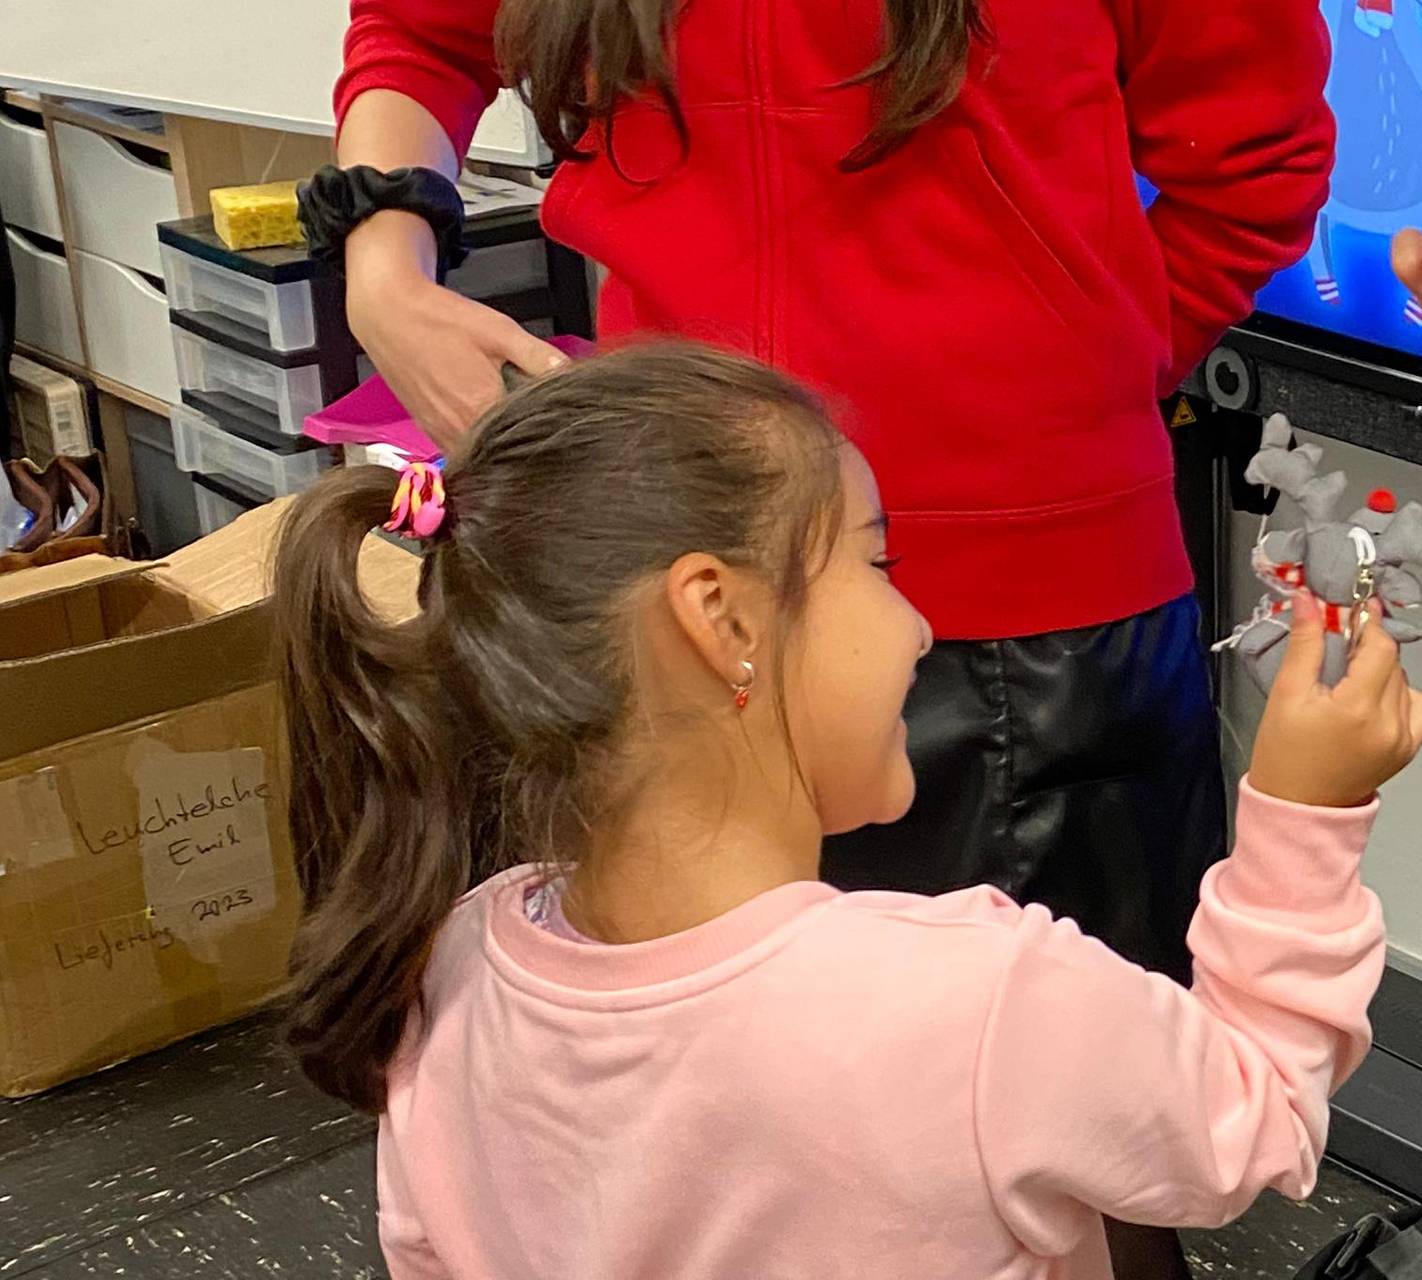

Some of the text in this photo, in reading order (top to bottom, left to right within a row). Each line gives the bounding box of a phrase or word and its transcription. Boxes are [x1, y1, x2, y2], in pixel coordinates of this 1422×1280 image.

[77, 777, 270, 855] Leuchtelche
[168, 825, 240, 866] Emil
[192, 889, 253, 921] 2023
[55, 925, 175, 970] Lieferung
